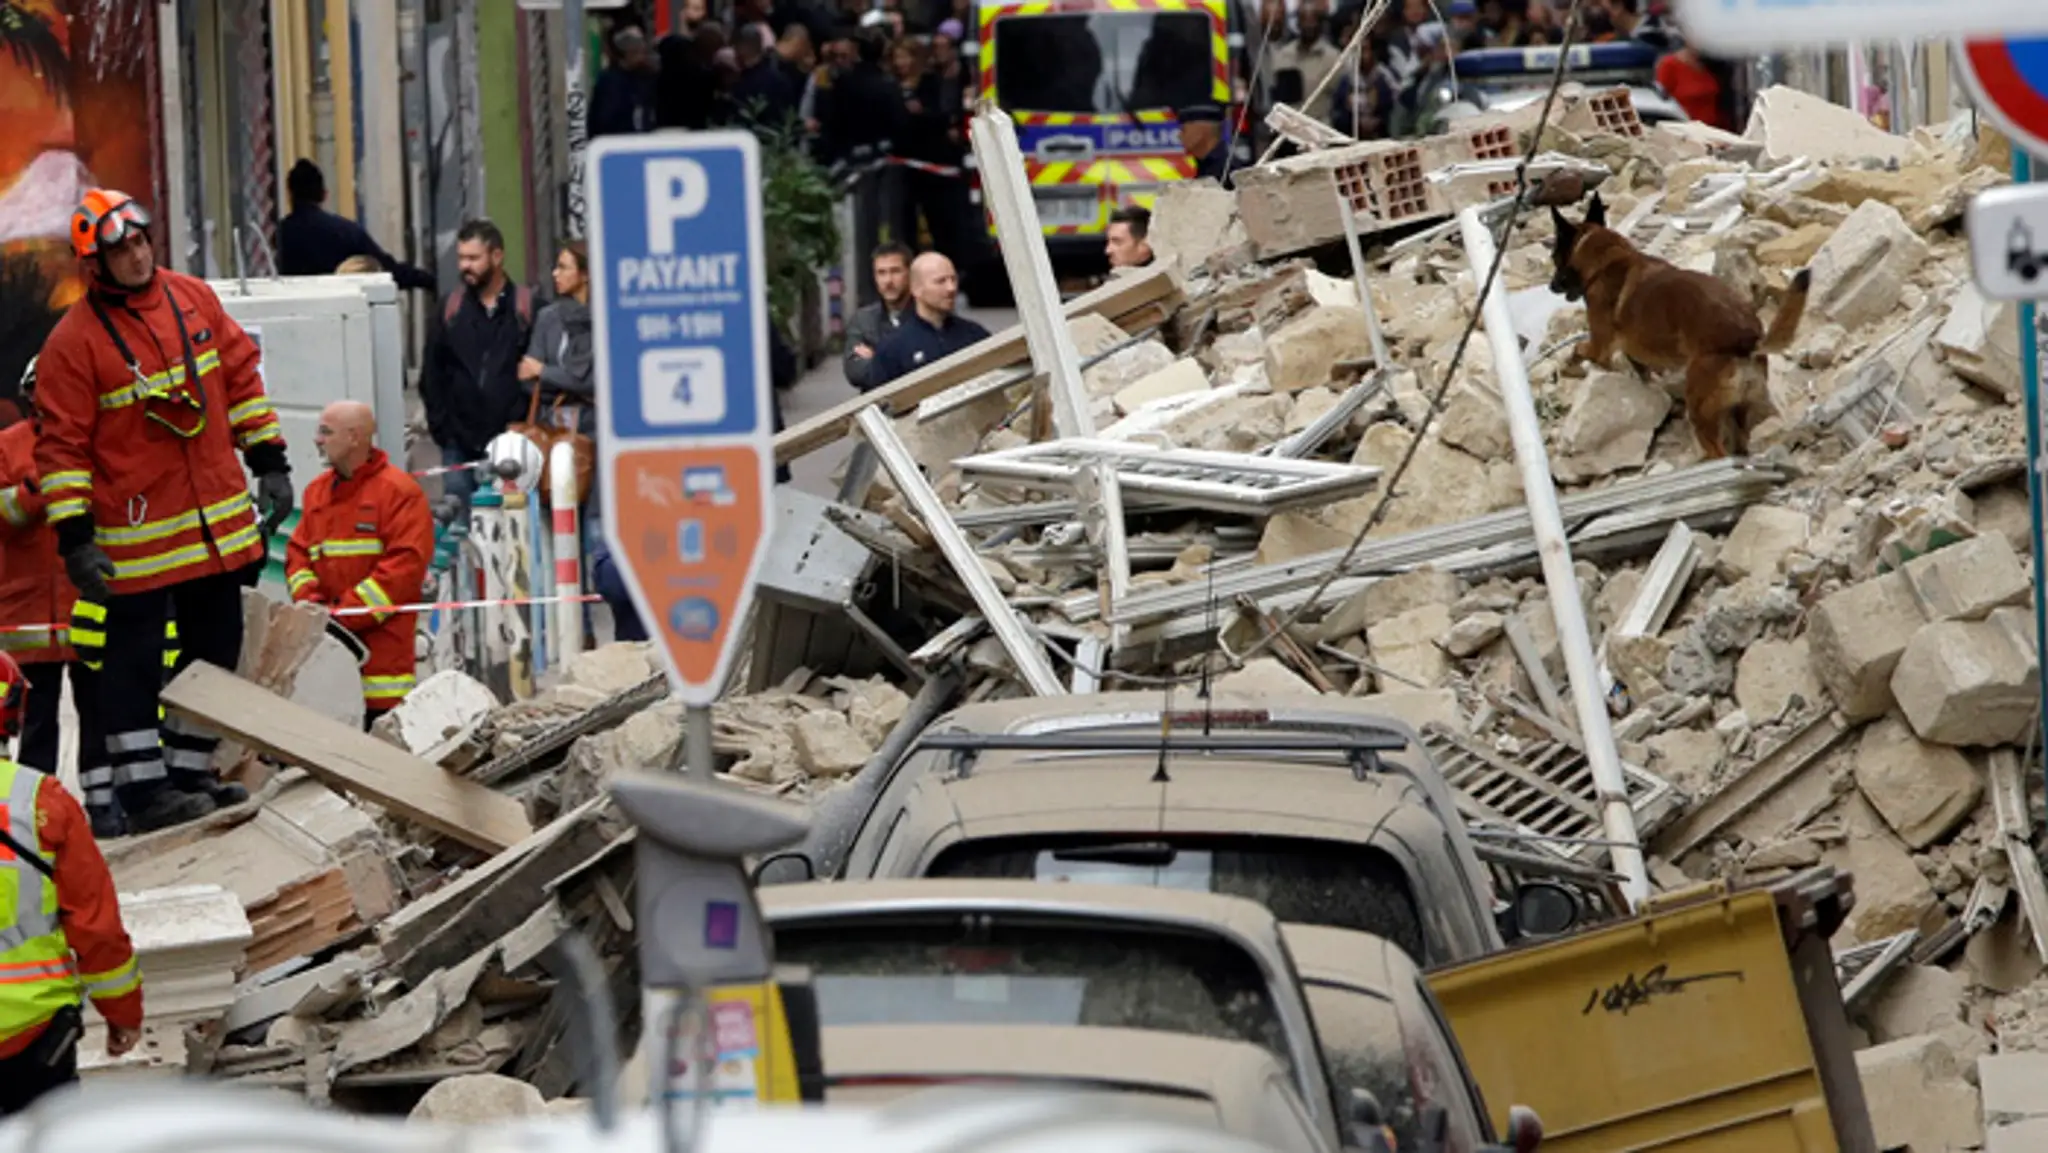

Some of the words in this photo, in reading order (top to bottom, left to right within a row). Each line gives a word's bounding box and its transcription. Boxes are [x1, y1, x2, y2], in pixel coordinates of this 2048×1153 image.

[1109, 128, 1183, 146] POLIC
[644, 156, 709, 255] P
[617, 253, 740, 293] PAYANT
[671, 373, 692, 407] 4
